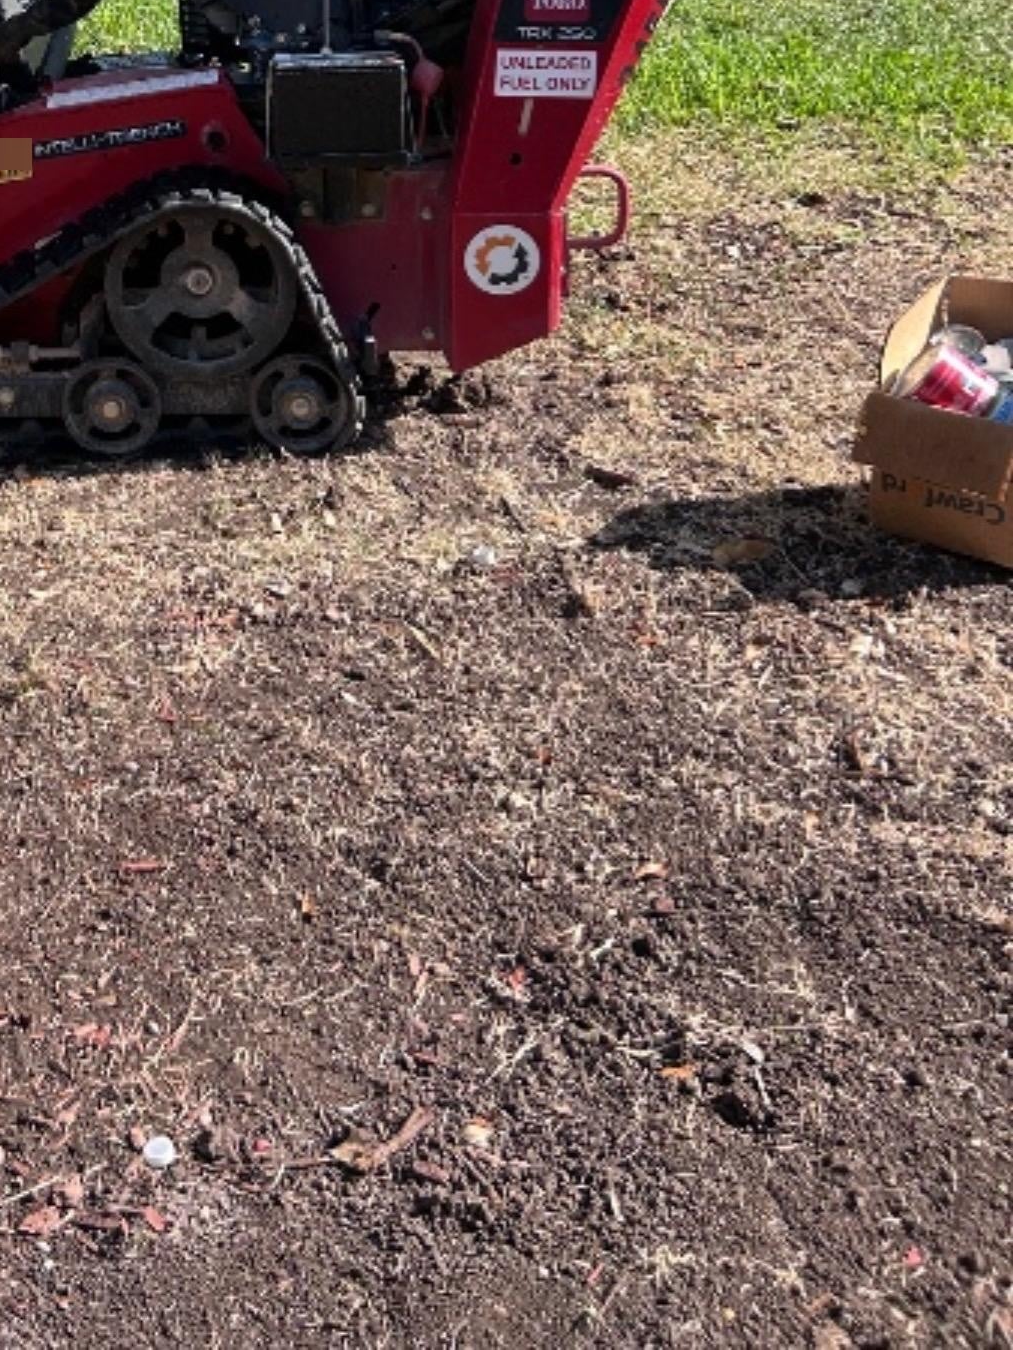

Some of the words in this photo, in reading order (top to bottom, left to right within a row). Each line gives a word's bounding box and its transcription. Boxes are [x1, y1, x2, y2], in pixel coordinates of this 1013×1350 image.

[500, 56, 592, 70] UNLEADED
[499, 76, 541, 90] FUEL
[545, 77, 591, 91] ONLY
[881, 471, 1006, 525] Crawfrd
